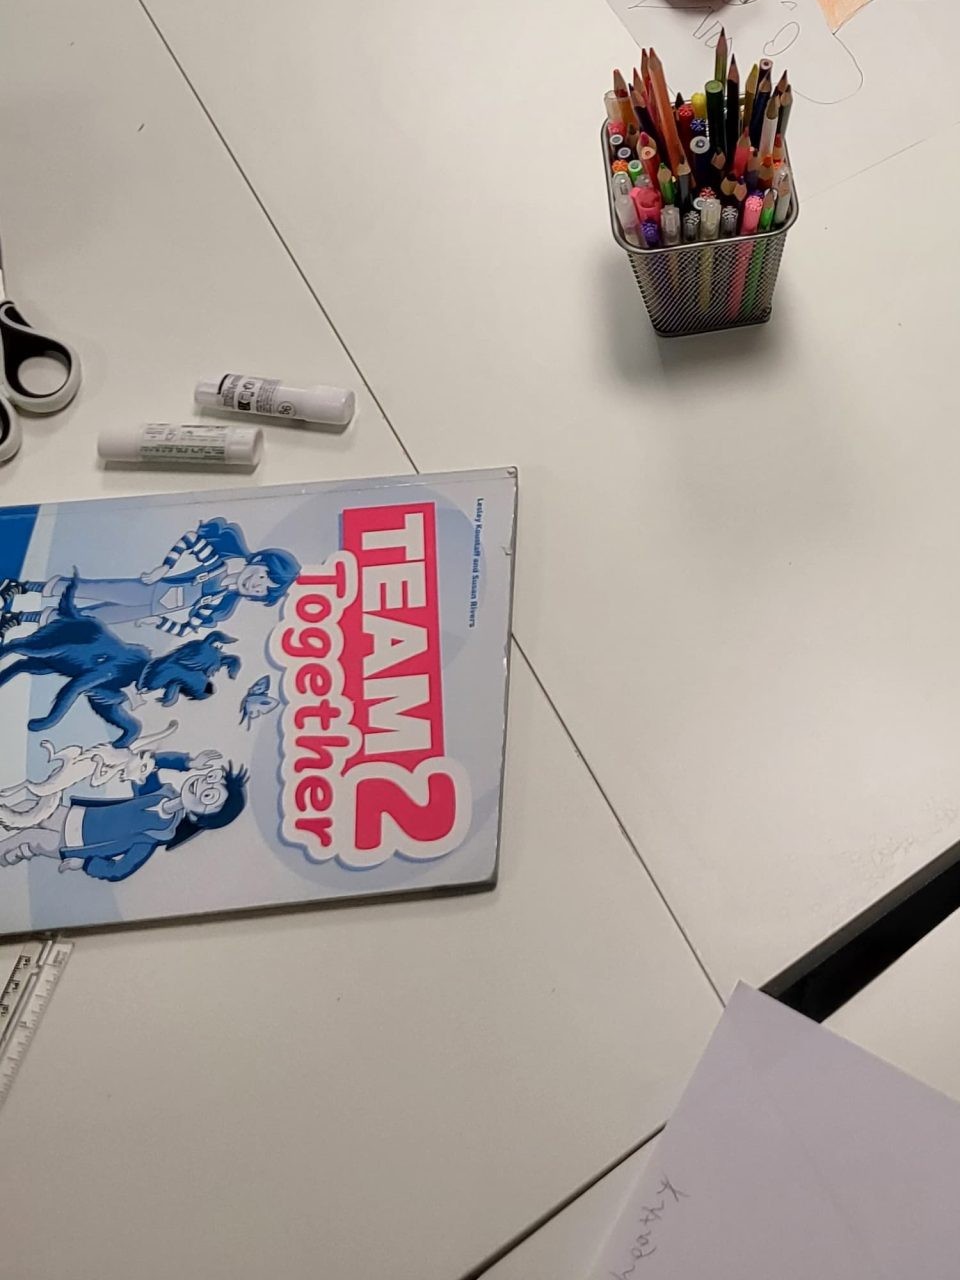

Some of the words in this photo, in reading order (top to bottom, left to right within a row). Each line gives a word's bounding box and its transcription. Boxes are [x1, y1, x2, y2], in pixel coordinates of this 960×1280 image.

[475, 498, 483, 521] Lesley
[473, 524, 481, 556] Koustaff
[470, 575, 478, 598] Susan
[469, 601, 477, 627] Rivers
[361, 513, 432, 756] TEAM
[282, 561, 347, 846] Together
[356, 773, 456, 849] 2
